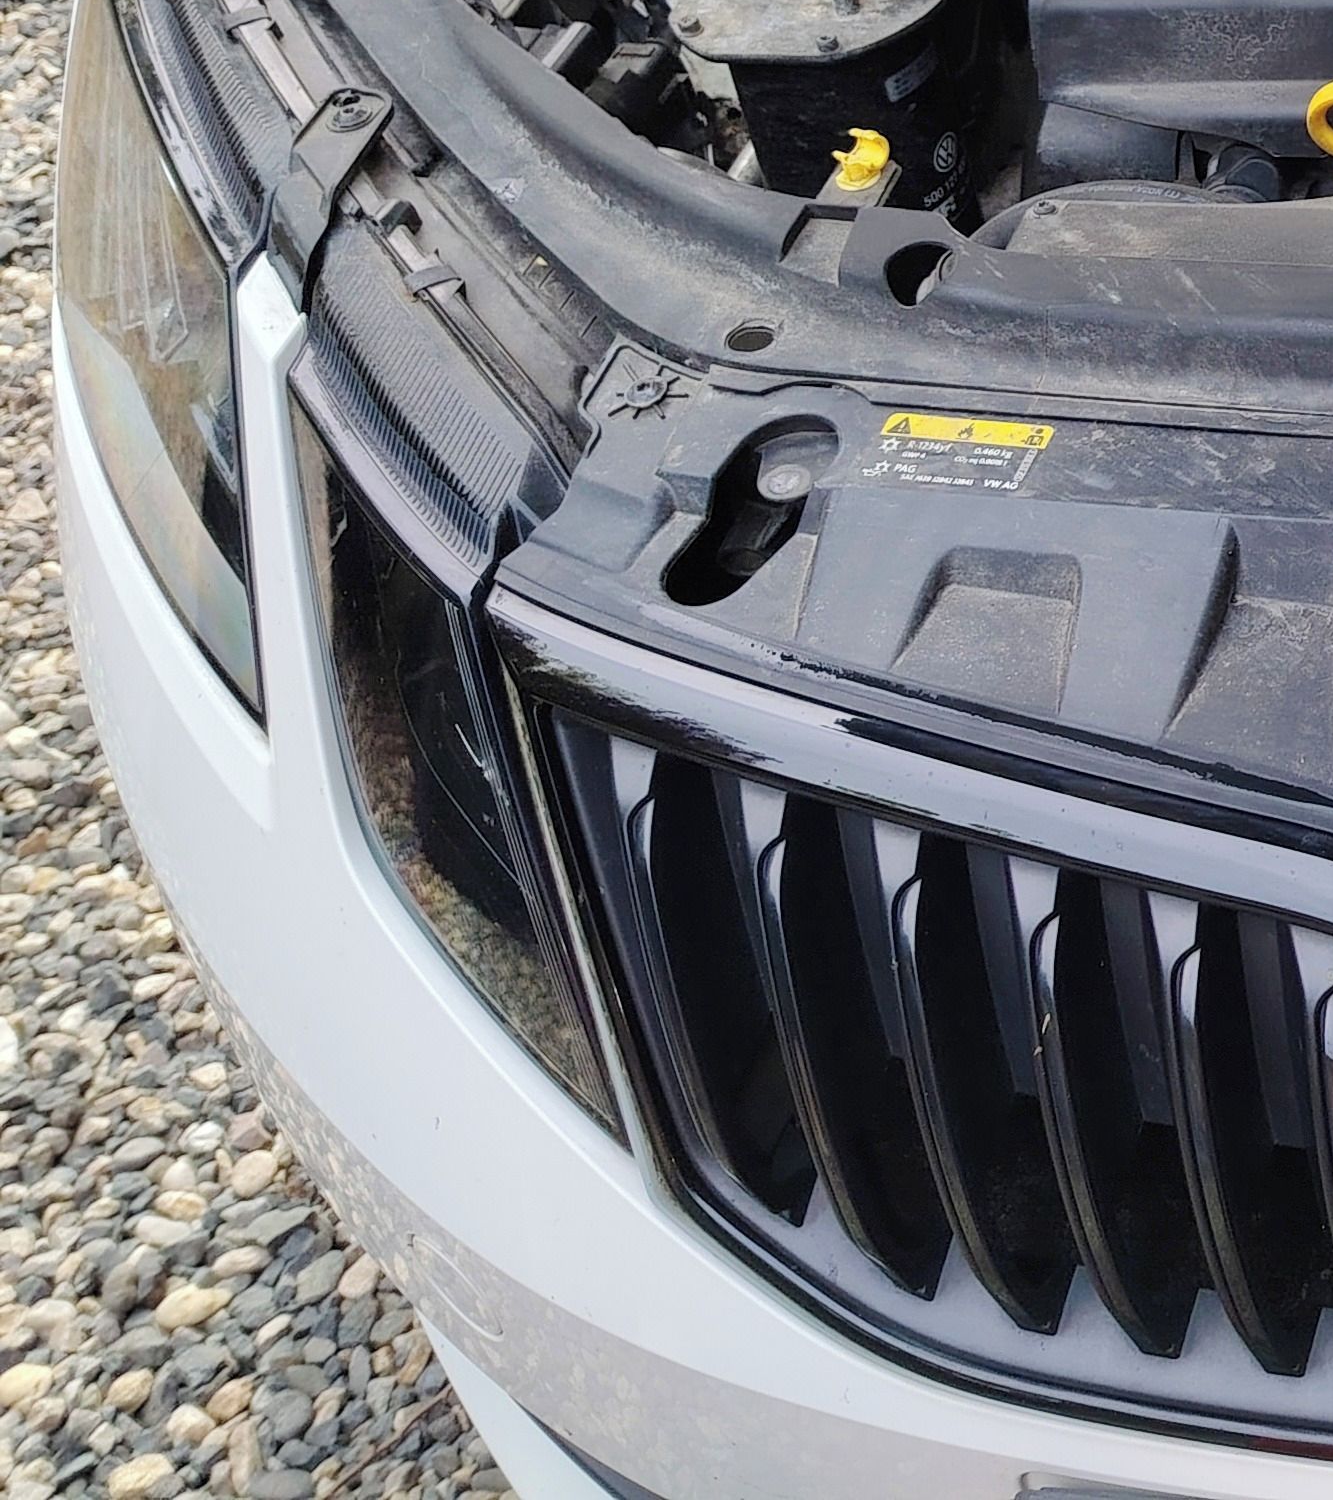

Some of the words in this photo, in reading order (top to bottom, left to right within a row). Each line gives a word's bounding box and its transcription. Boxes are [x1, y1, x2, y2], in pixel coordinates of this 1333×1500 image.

[1000, 449, 1014, 459] kg
[893, 464, 918, 473] PAG
[984, 479, 1001, 489] VW
[1001, 481, 1019, 490] AG
